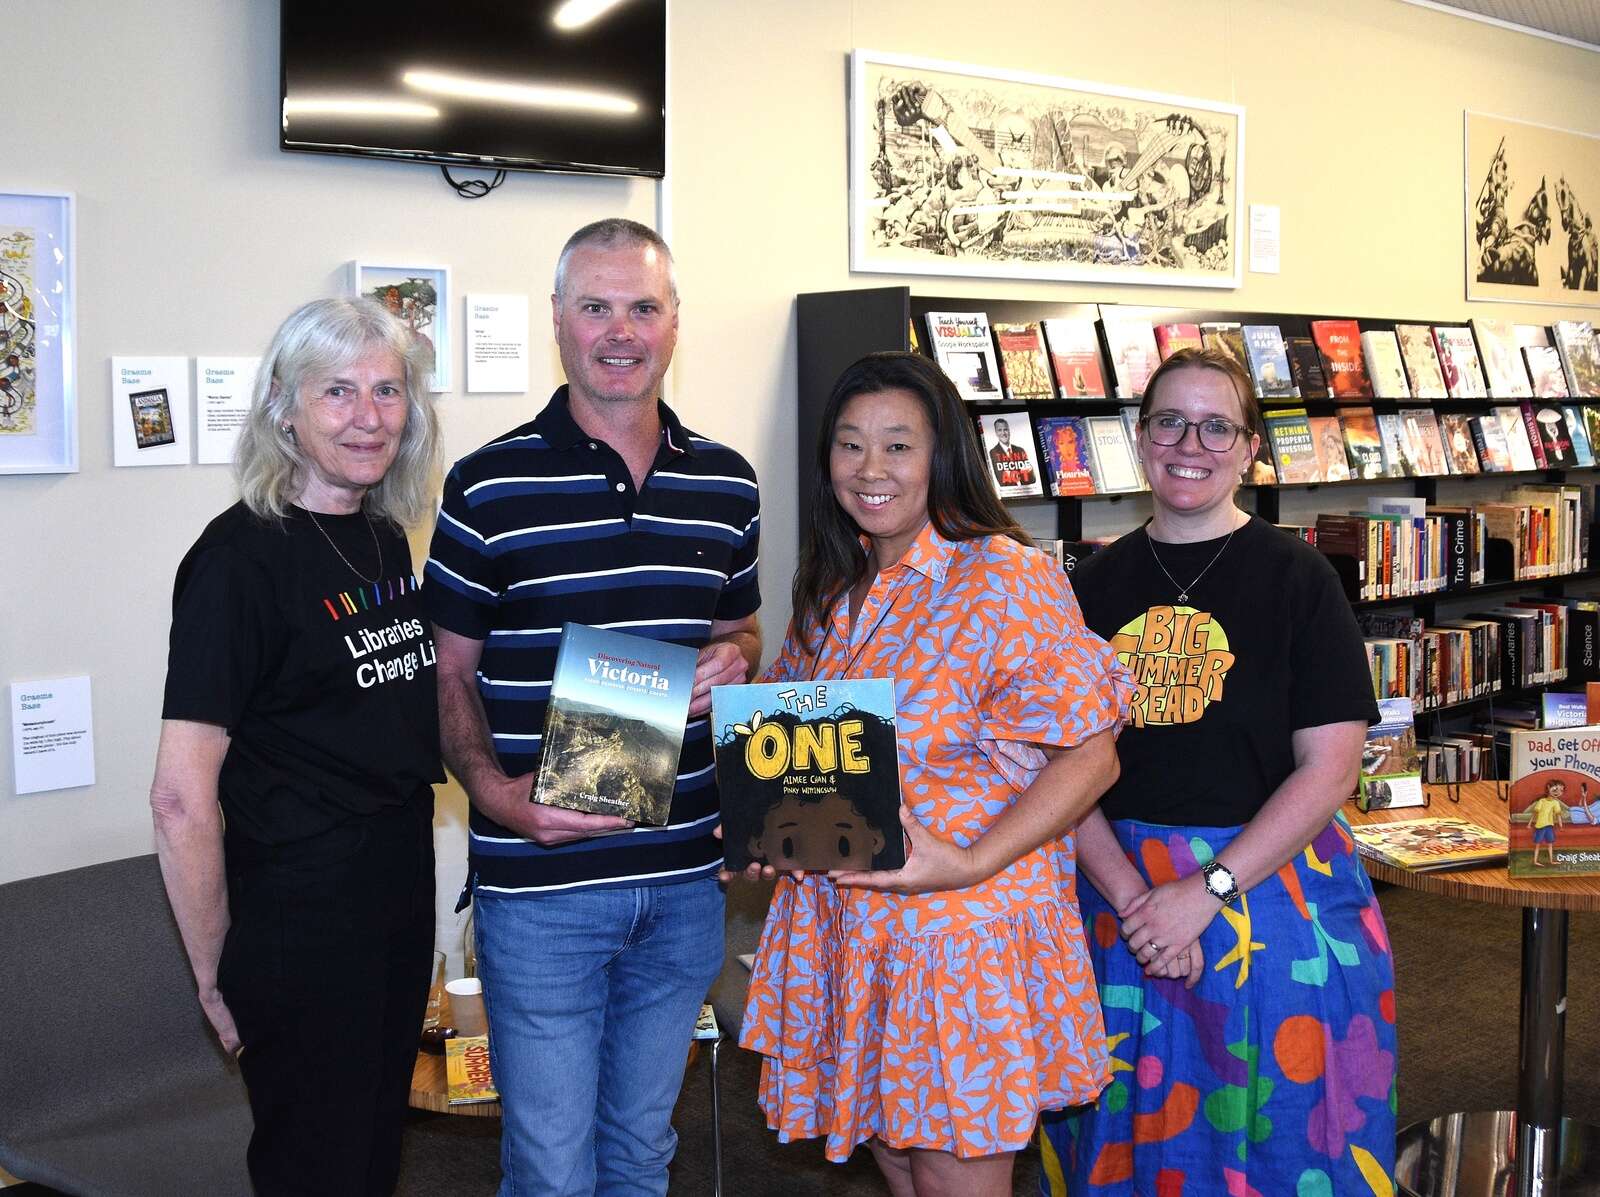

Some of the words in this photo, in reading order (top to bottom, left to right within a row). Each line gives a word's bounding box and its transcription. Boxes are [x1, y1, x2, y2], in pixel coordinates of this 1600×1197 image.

[1331, 361, 1362, 372] INSIDE
[1276, 434, 1311, 445] PROPERTY
[1454, 519, 1464, 554] Crime
[1454, 556, 1464, 584] True
[344, 618, 424, 659] Libraries
[1139, 605, 1211, 656] BIG
[1583, 624, 1593, 667] Science
[356, 651, 419, 689] Change
[588, 657, 670, 691] Victoria
[777, 685, 828, 714] THE
[1128, 683, 1205, 729] READ
[745, 719, 871, 780] ONE
[1528, 737, 1555, 753] Dad,
[1557, 738, 1579, 752] Get
[783, 775, 808, 785] AIMEE
[1530, 757, 1561, 771] your
[1564, 754, 1600, 778] Phone
[579, 791, 599, 802] Craig
[1556, 853, 1577, 865] Craig
